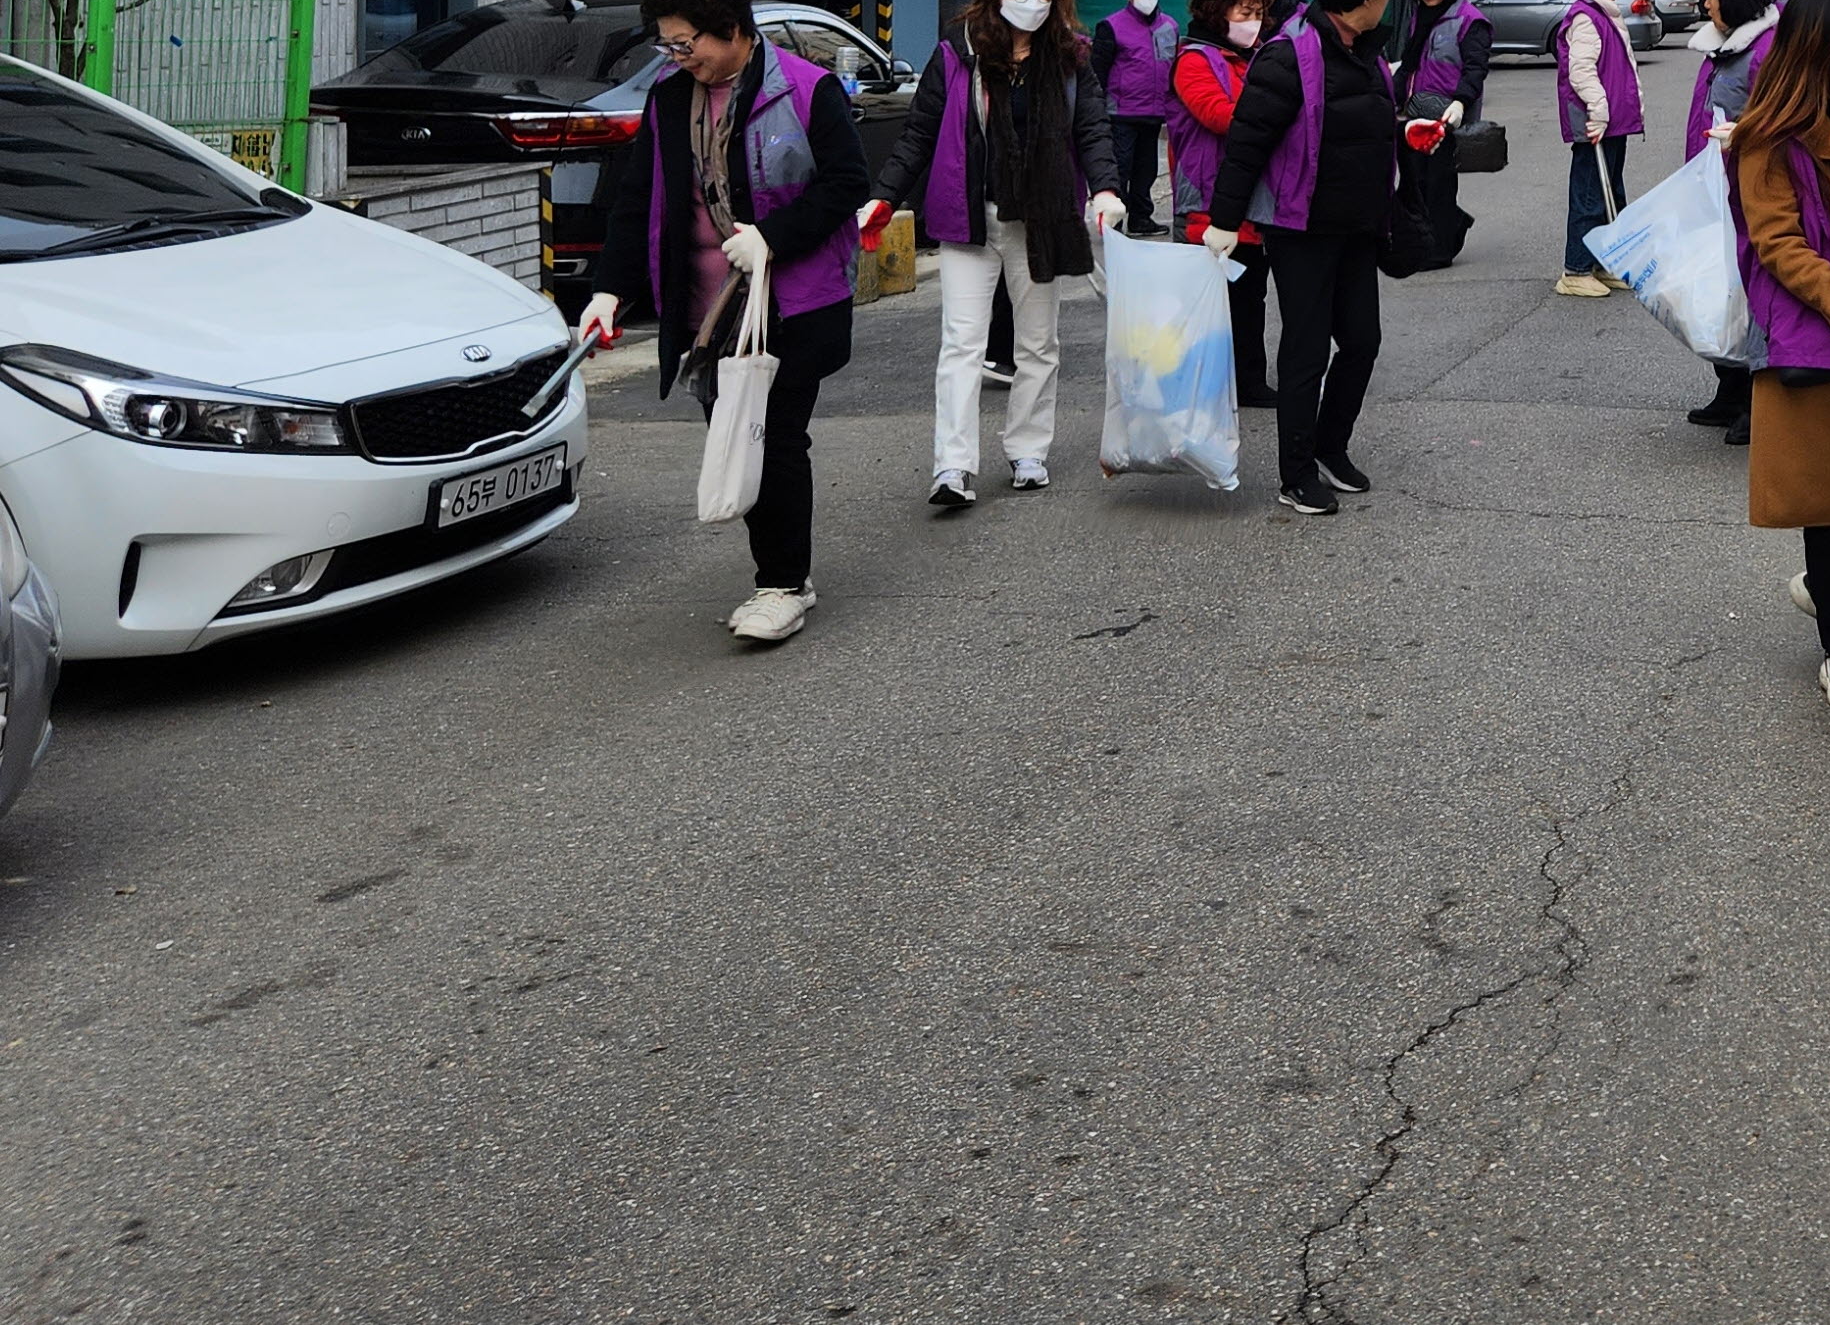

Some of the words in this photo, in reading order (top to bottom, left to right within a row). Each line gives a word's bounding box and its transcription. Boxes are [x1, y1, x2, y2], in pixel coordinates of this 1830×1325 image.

[405, 129, 426, 140] KIA
[462, 345, 490, 363] KIA
[451, 476, 497, 518] 65부
[505, 453, 556, 501] 0137
